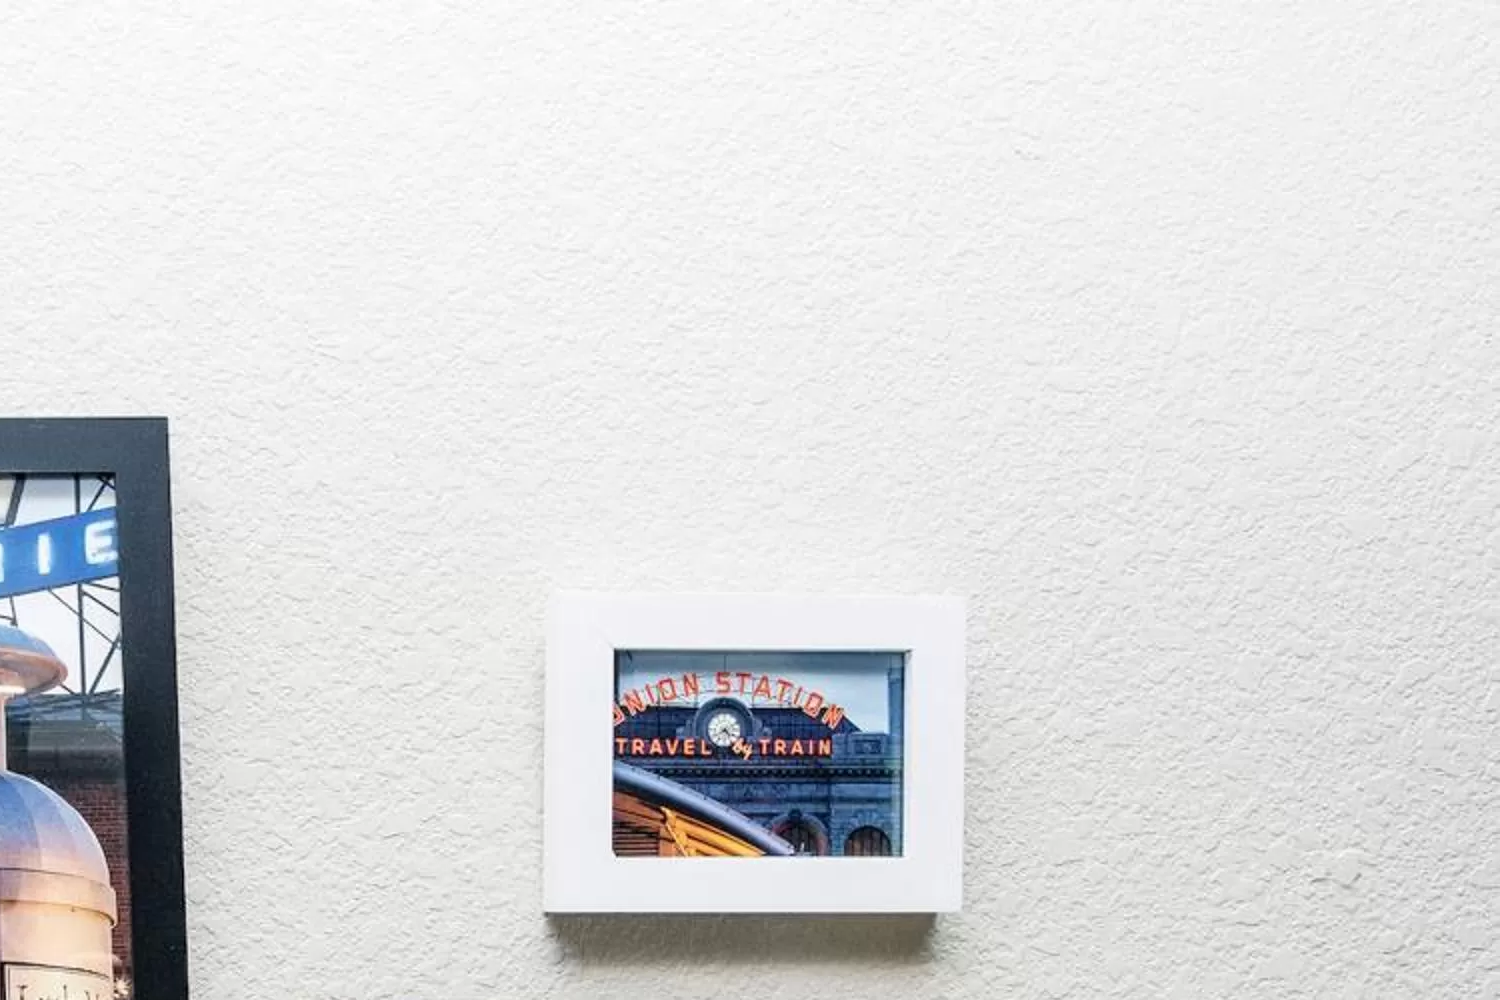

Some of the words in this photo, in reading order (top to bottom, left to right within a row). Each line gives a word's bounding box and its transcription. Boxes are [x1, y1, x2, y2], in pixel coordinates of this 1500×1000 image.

[714, 671, 846, 729] STATION
[615, 737, 712, 756] TRAVEL
[759, 738, 831, 755] TRAIN
